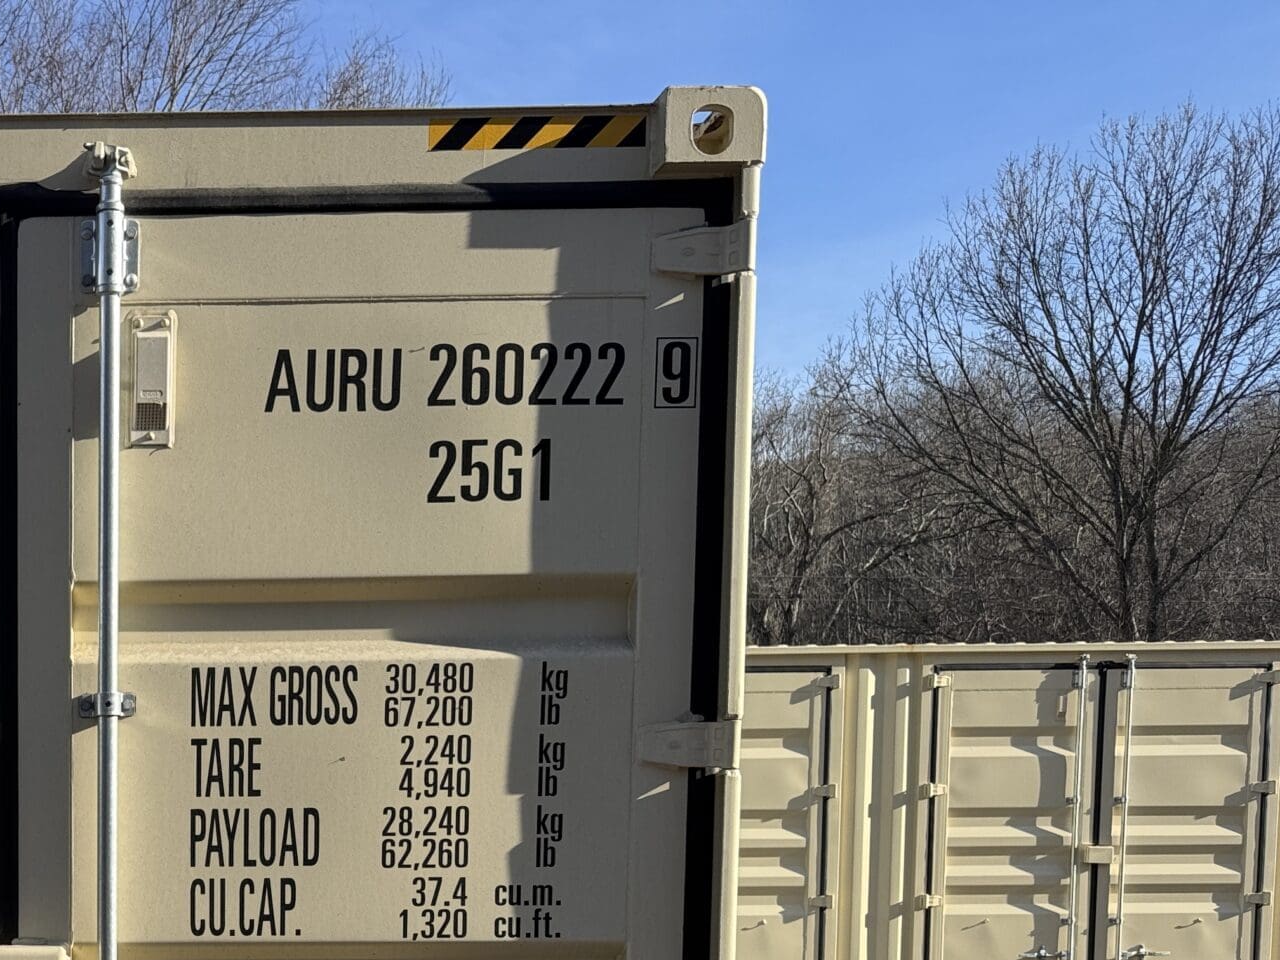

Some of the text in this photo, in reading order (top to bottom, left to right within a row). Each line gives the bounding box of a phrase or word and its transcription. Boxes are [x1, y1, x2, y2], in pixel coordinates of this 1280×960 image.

[264, 341, 691, 413] AURU 260222 9
[427, 438, 552, 503] 25G1
[190, 665, 359, 727] MAX GROSS
[385, 661, 568, 700] 30,480 kg
[384, 695, 561, 729] 67,200 lb
[190, 737, 262, 798] TARE
[400, 734, 566, 770] 2,240 kg
[398, 766, 558, 800] 4,940 lb
[190, 807, 320, 868] PAYLOAD
[382, 805, 564, 841] 28,240 kg
[381, 838, 556, 871] 62,260 lb
[190, 877, 301, 937] CU.CAP.
[411, 876, 562, 907] 37.4 cu.m.
[400, 909, 562, 941] 1,320 cu.ft.
